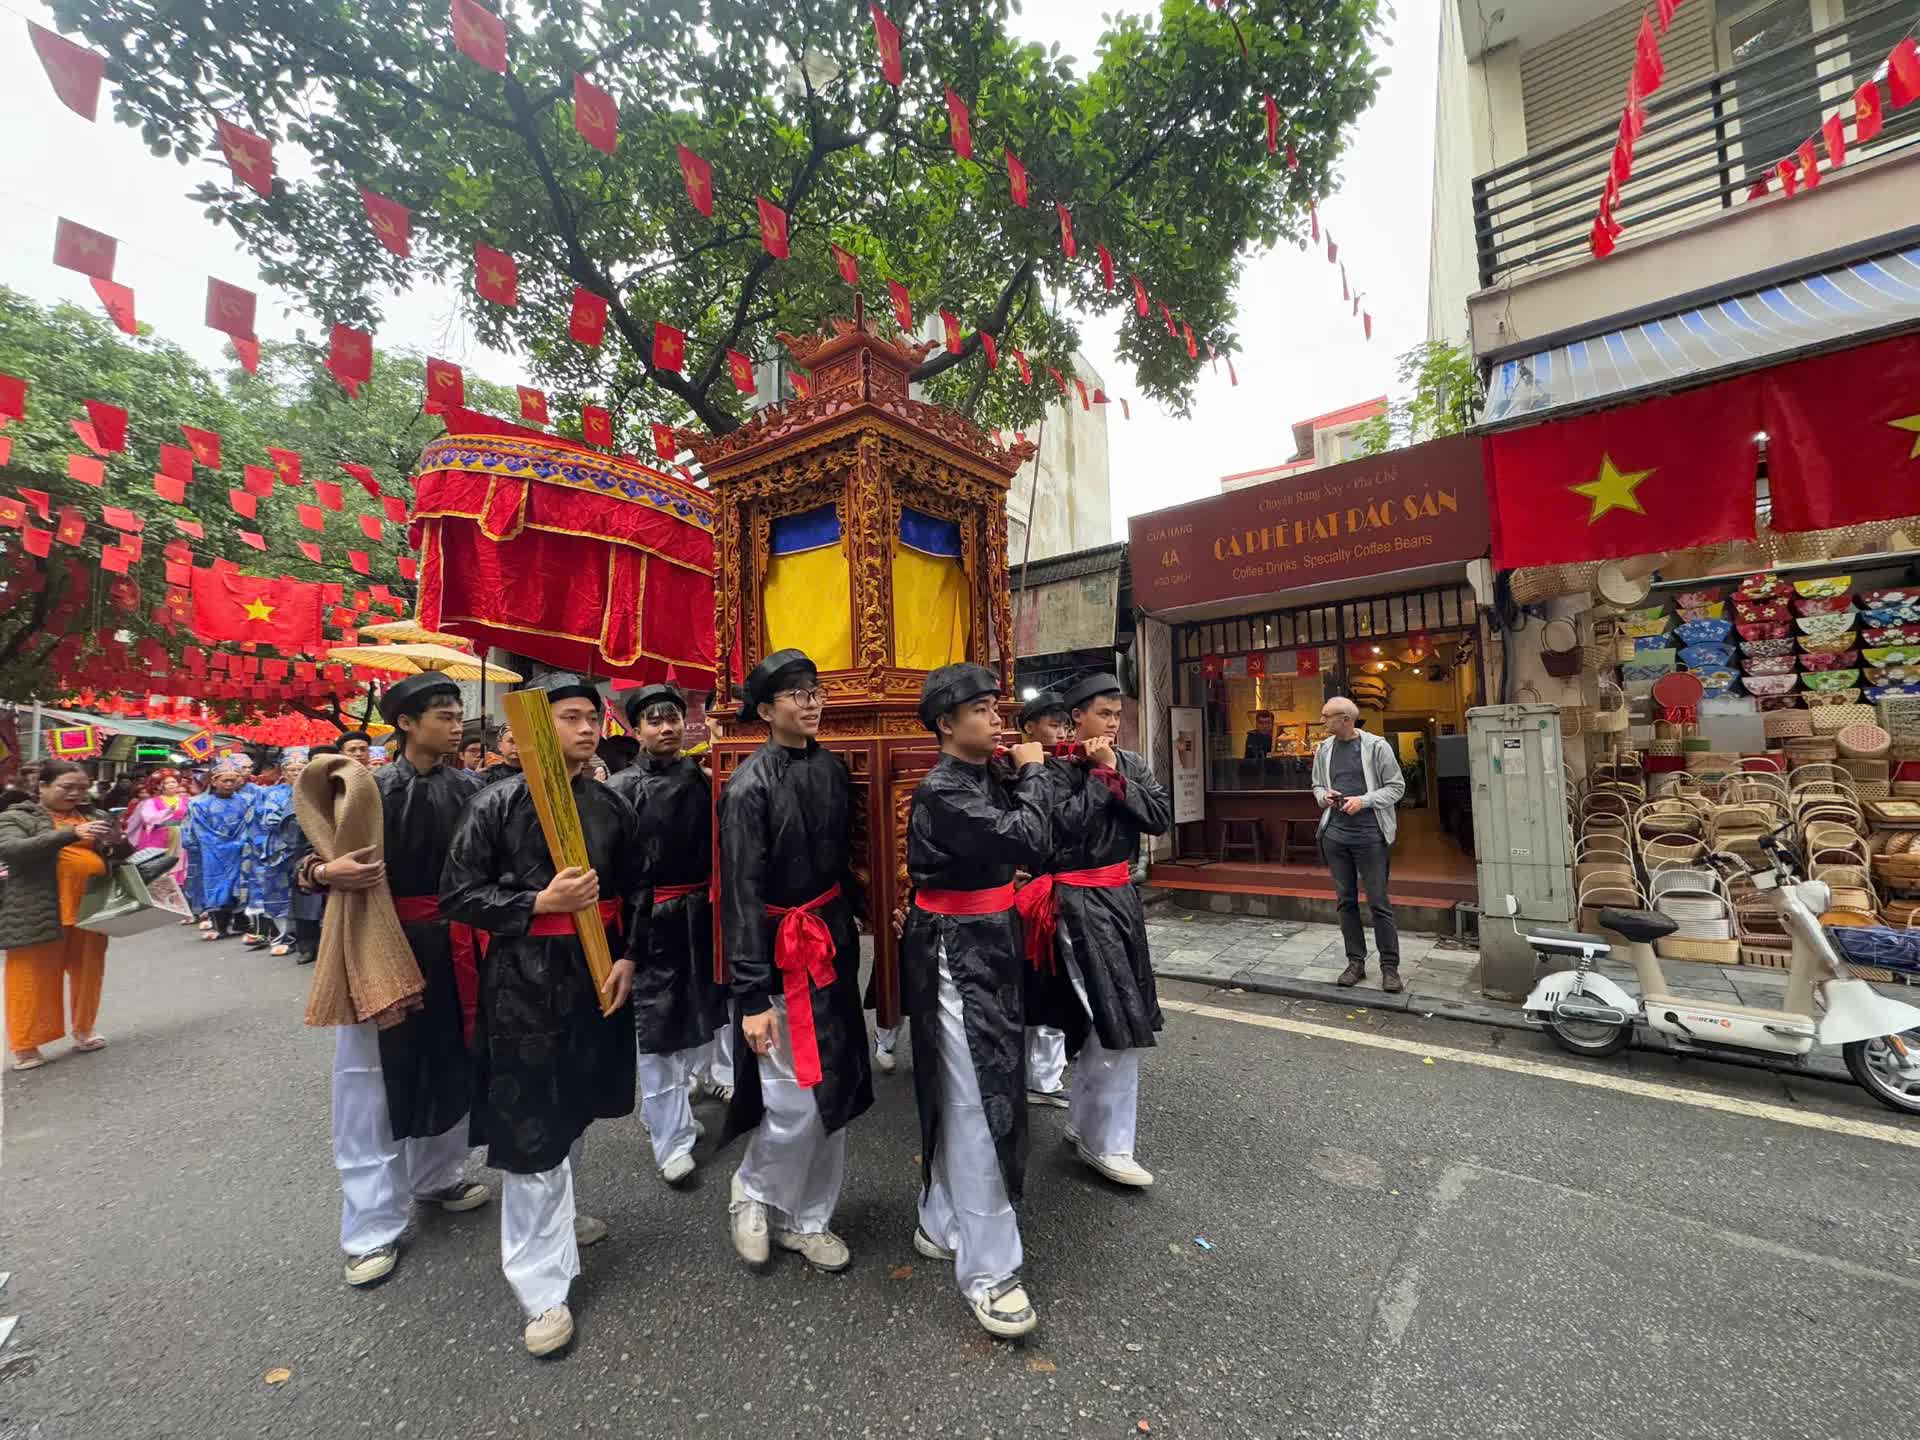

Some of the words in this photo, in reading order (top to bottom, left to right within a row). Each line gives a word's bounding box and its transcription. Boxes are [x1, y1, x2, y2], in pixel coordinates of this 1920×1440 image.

[1246, 517, 1289, 553] PHÊ
[1161, 550, 1180, 568] 4A
[1233, 566, 1264, 580] Coffee
[1303, 548, 1351, 569] Specialty
[1354, 541, 1391, 558] Coffee
[1394, 534, 1433, 551] Beans
